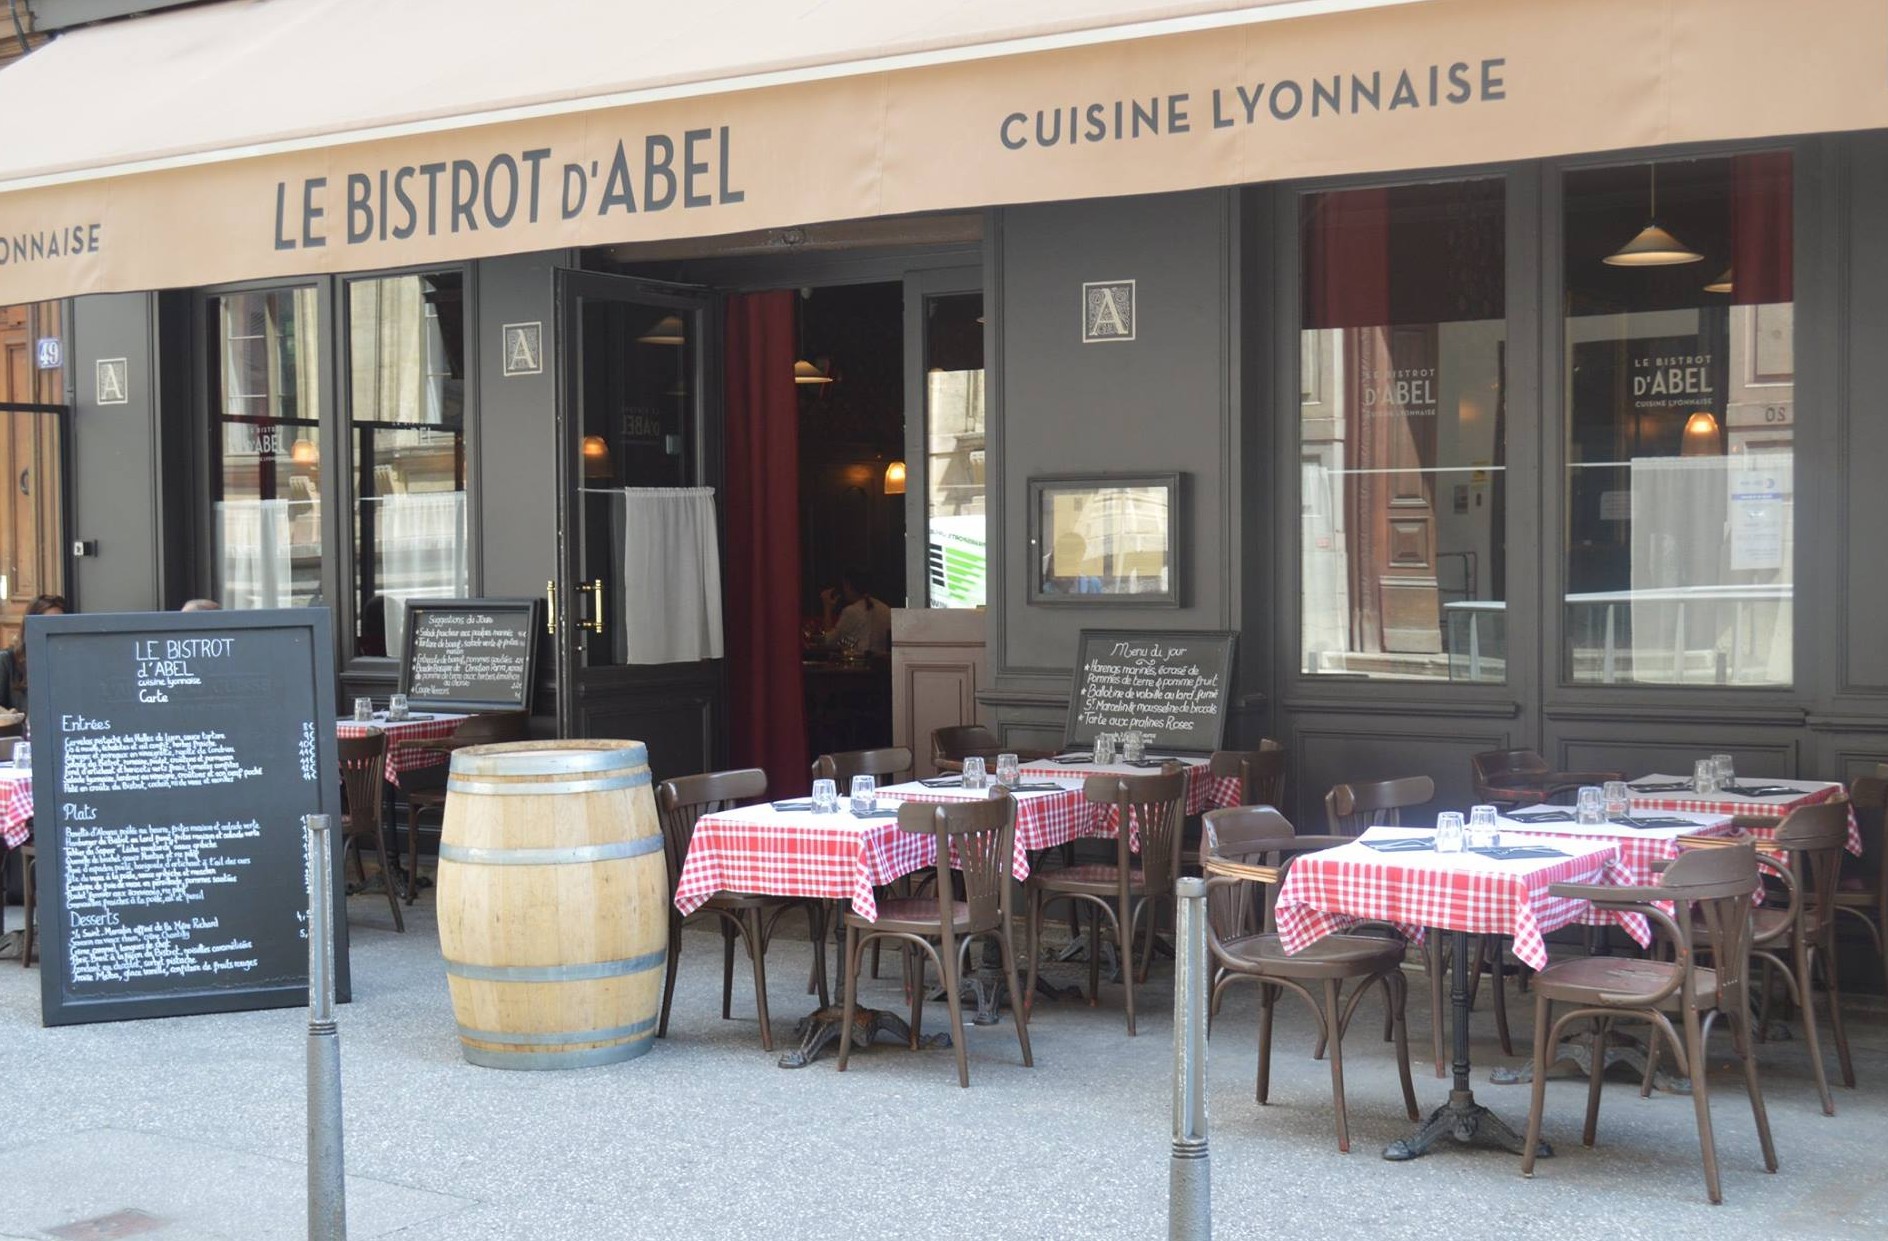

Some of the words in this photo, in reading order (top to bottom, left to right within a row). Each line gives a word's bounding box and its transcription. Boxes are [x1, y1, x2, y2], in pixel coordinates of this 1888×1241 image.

[999, 93, 1191, 150] CUISINE
[1213, 58, 1507, 129] LYONNAISE
[274, 177, 328, 250] LE
[346, 147, 552, 245] BISTROT
[561, 126, 745, 220] D'ABEL
[1088, 286, 1130, 336] A
[41, 342, 59, 364] 49
[508, 327, 538, 371] A
[1635, 359, 1649, 367] LE
[1656, 355, 1711, 366] BISTROT
[98, 361, 125, 402] A
[1634, 368, 1713, 395] D'ABEL
[1365, 380, 1436, 405] D'ABEL
[1635, 399, 1666, 408] CUISINE
[1668, 398, 1712, 406] LYONNAISE
[136, 641, 159, 661] LE
[167, 639, 234, 658] BISTROT
[1110, 642, 1147, 658] Menu
[1151, 644, 1162, 656] du
[1163, 647, 1187, 661] jour
[137, 662, 194, 677] d'ABEL
[1188, 664, 1199, 675] de
[137, 678, 165, 686] cuisine
[167, 677, 201, 688] lyonnaise
[1122, 676, 1132, 684] de
[139, 689, 169, 703] Carte
[1125, 688, 1134, 698] de
[1176, 690, 1194, 700] lard
[62, 715, 111, 731] Entrées
[1084, 712, 1106, 724] Tarte
[1109, 718, 1128, 726] aux
[1166, 716, 1194, 730] Roses
[63, 804, 97, 820] Plats
[71, 908, 120, 927] Desserts
